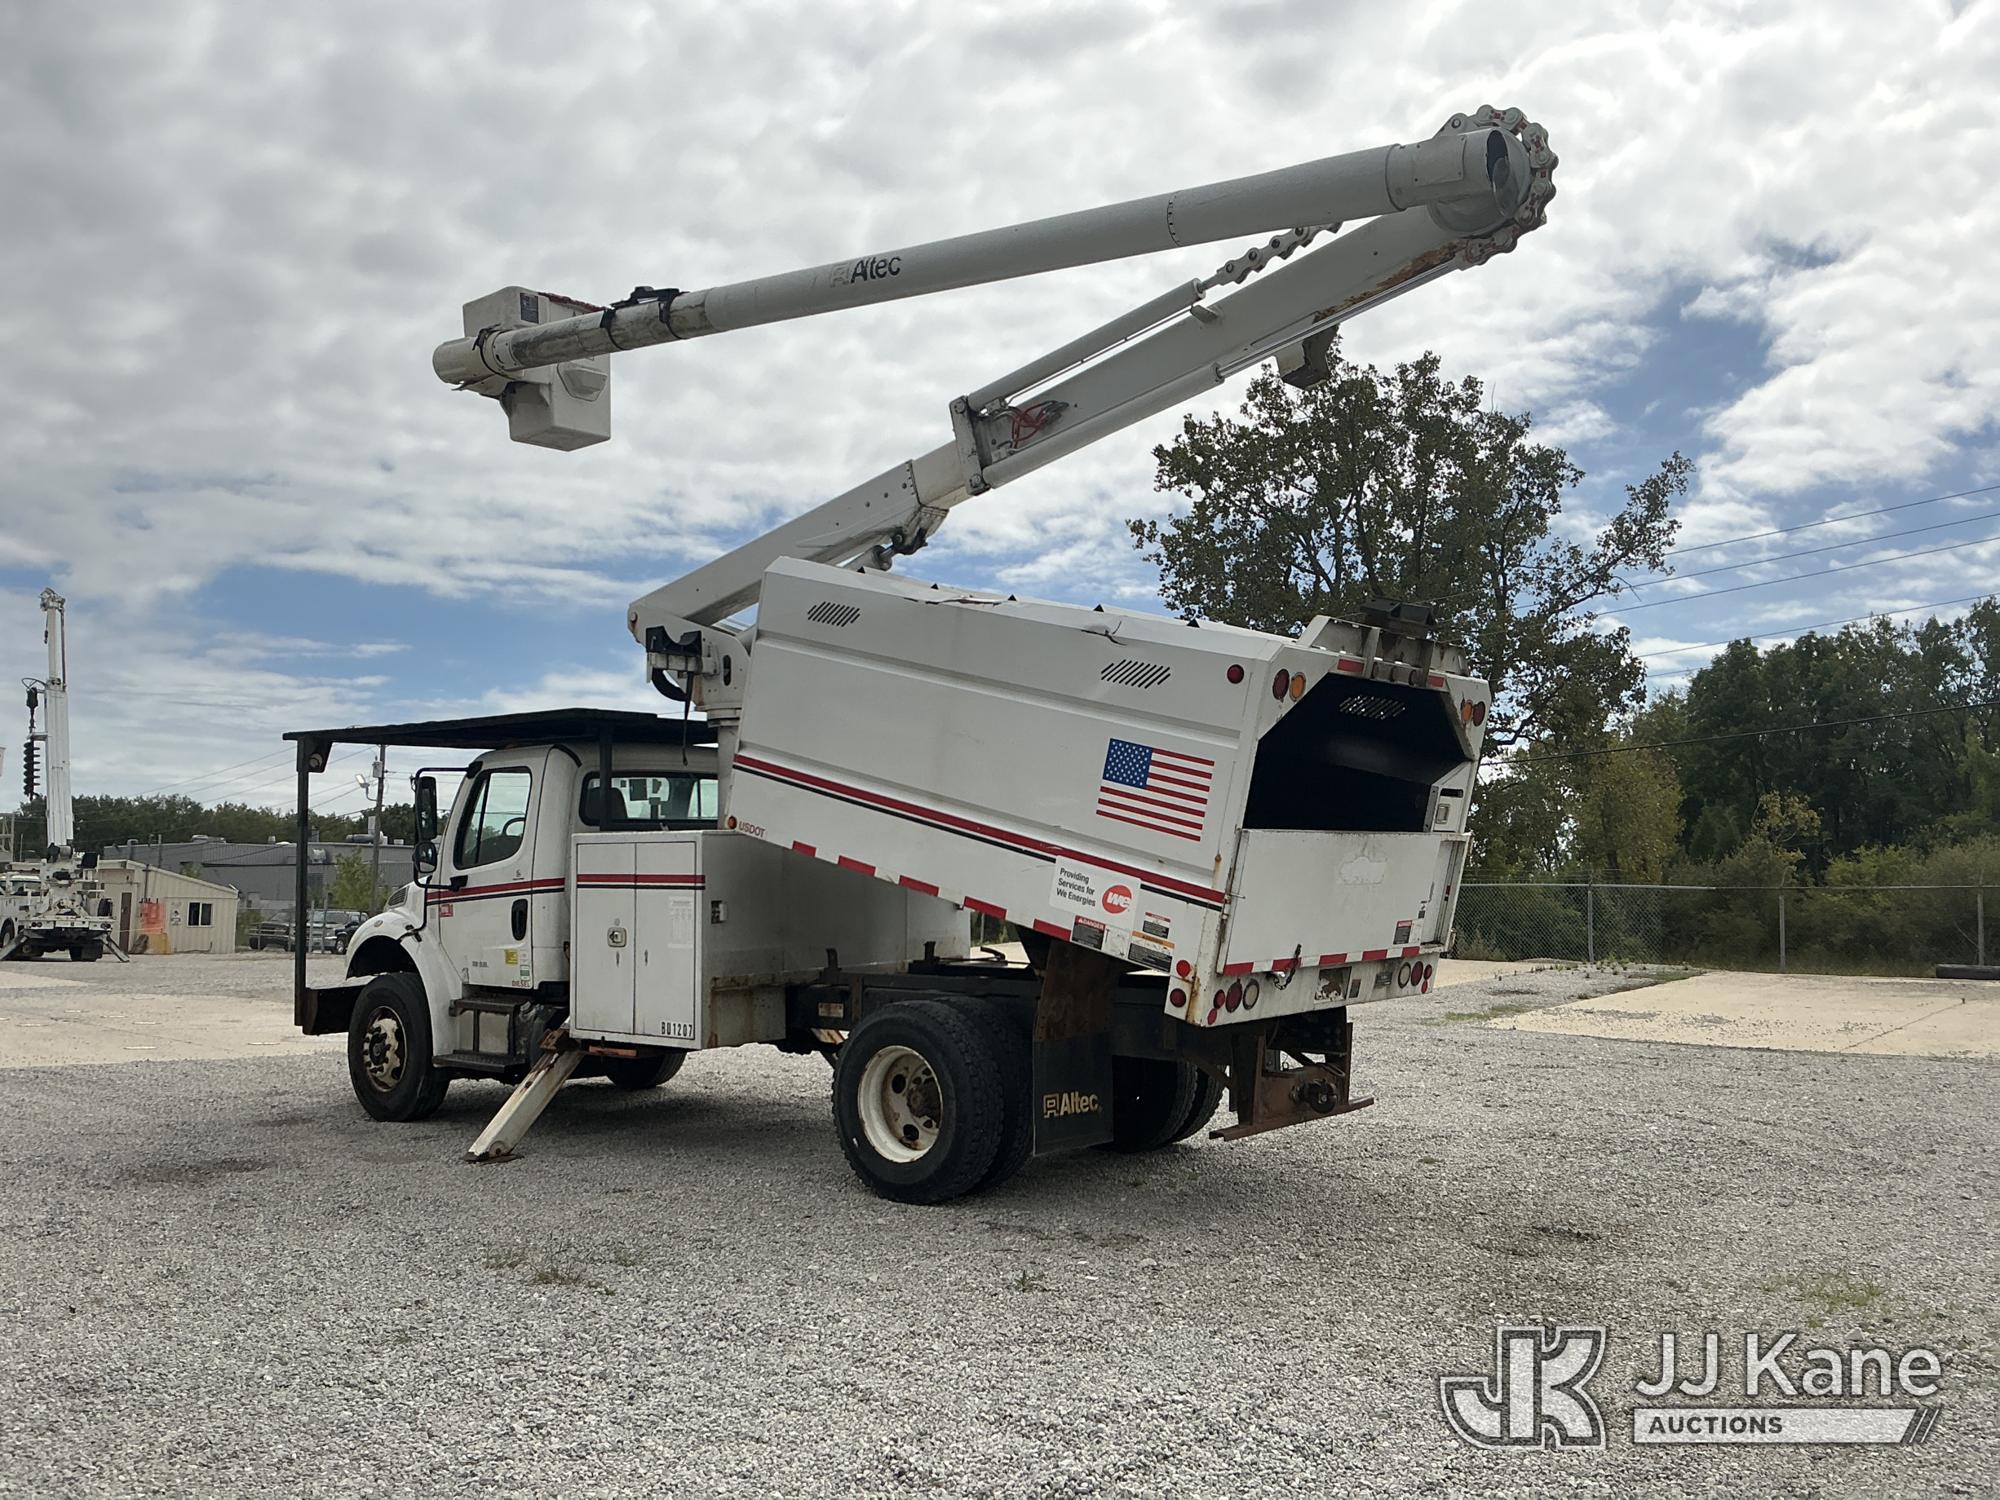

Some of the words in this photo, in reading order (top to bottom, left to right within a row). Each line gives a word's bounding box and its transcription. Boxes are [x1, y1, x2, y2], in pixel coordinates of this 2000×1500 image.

[851, 257, 902, 283] Altec
[739, 821, 765, 837] USDOT
[1059, 867, 1090, 885] Providing
[1058, 878, 1085, 893] Services
[1086, 886, 1095, 896] for
[1056, 888, 1067, 898] We
[1068, 892, 1096, 907] Energies
[1060, 1091, 1099, 1116] Altec
